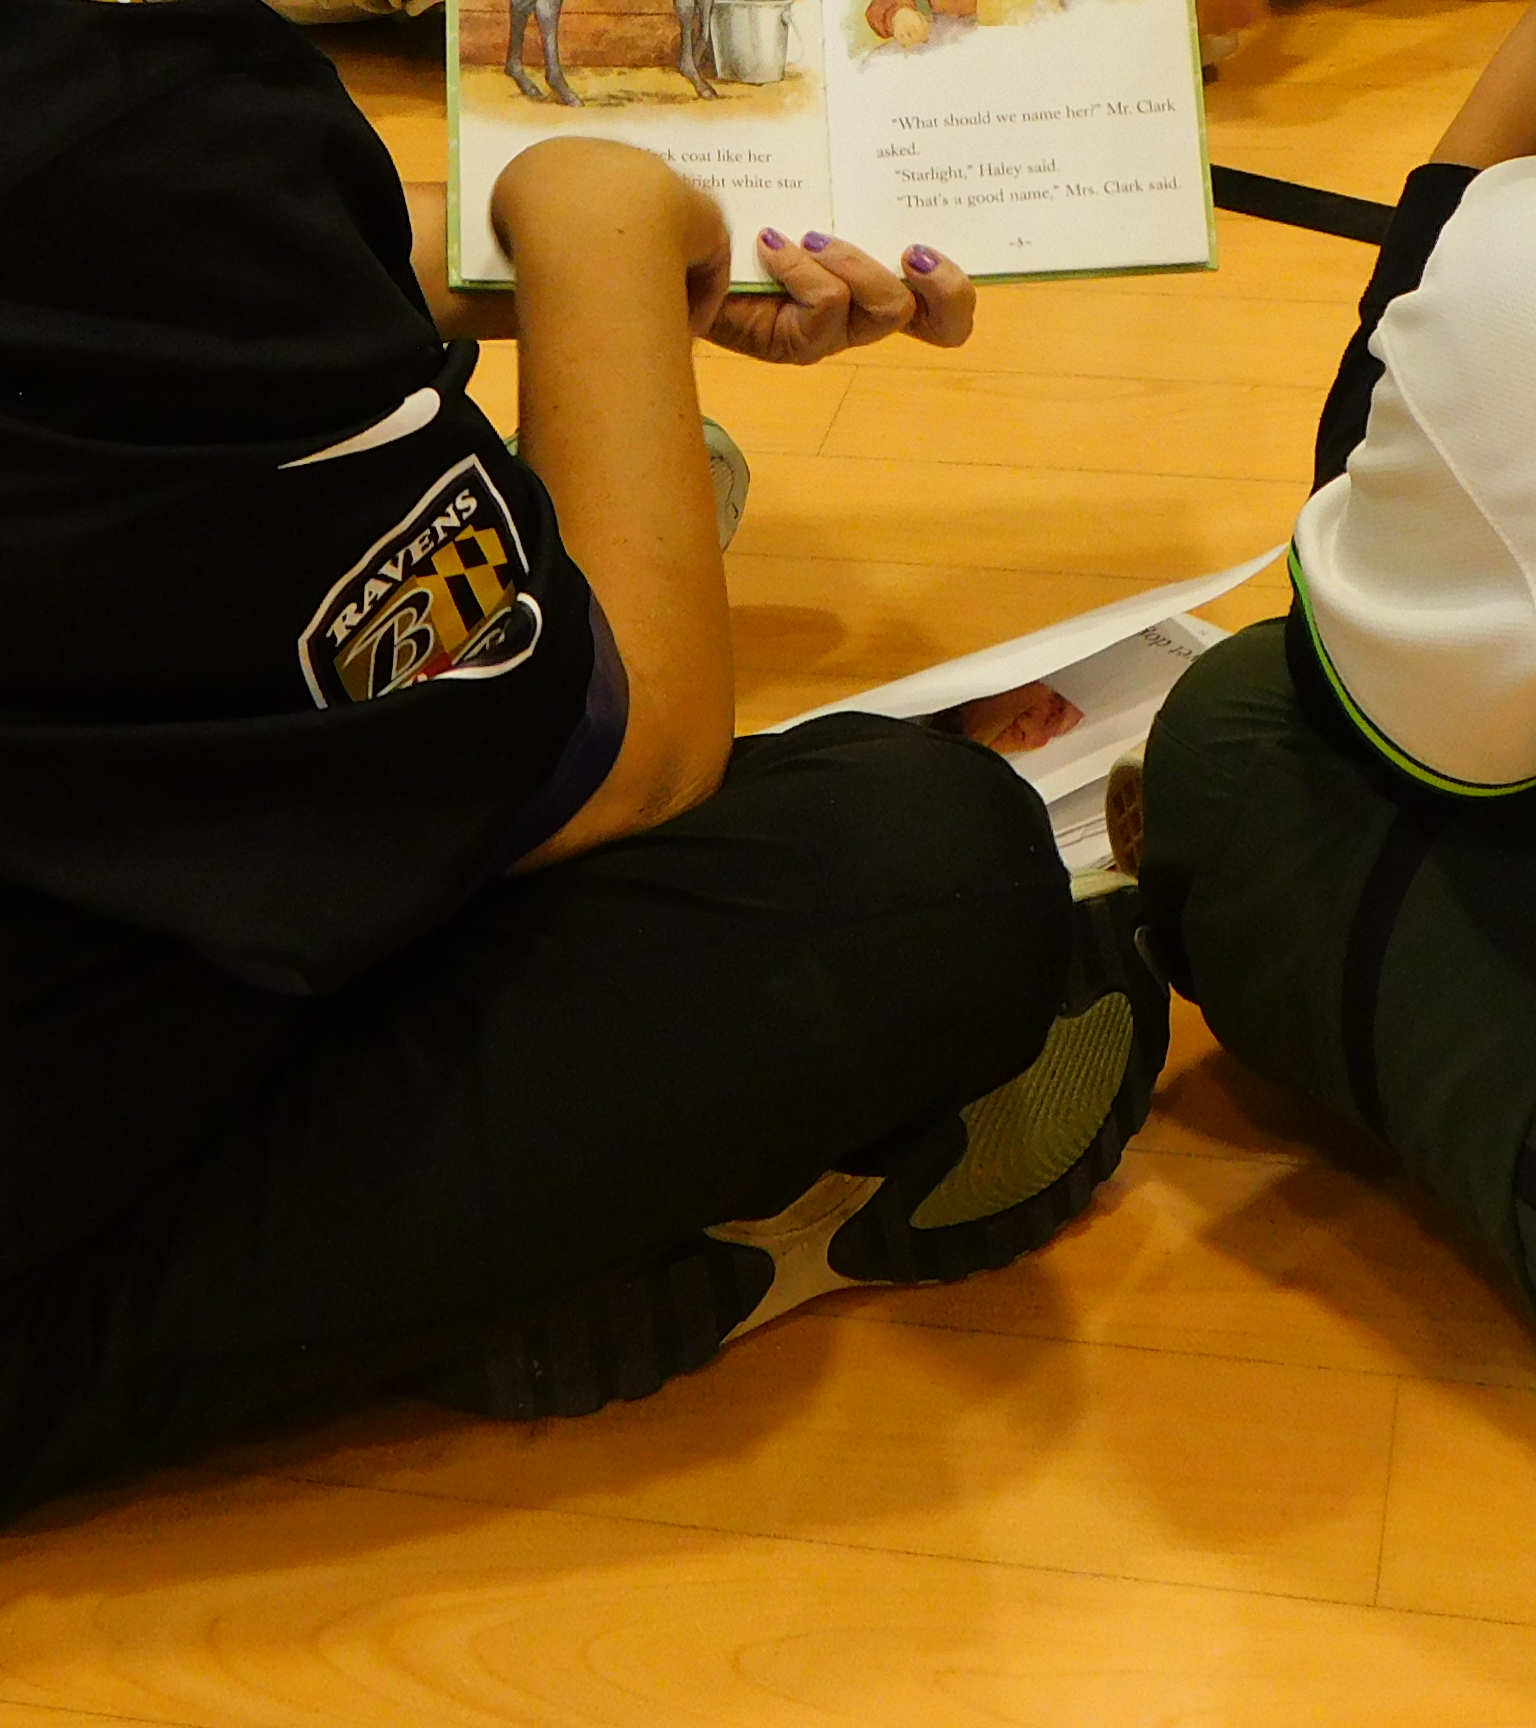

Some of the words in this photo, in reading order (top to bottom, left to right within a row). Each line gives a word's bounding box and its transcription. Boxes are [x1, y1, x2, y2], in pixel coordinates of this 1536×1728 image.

[943, 110, 992, 128] should
[996, 113, 1017, 123] we
[1022, 108, 1061, 122] name
[1107, 101, 1133, 117] Mr.
[1136, 98, 1177, 114] Clark
[681, 150, 712, 163] coat
[717, 149, 743, 163] like
[748, 149, 773, 163] her
[876, 142, 921, 159] asked.
[979, 161, 1021, 179] Haley
[682, 173, 726, 189] bright
[731, 174, 772, 189] white
[777, 177, 804, 189] star
[954, 195, 962, 206] a
[967, 188, 1005, 208] good
[1065, 183, 1099, 198] Mrs.
[1103, 178, 1144, 195] Clark
[325, 488, 479, 648] RAVENS
